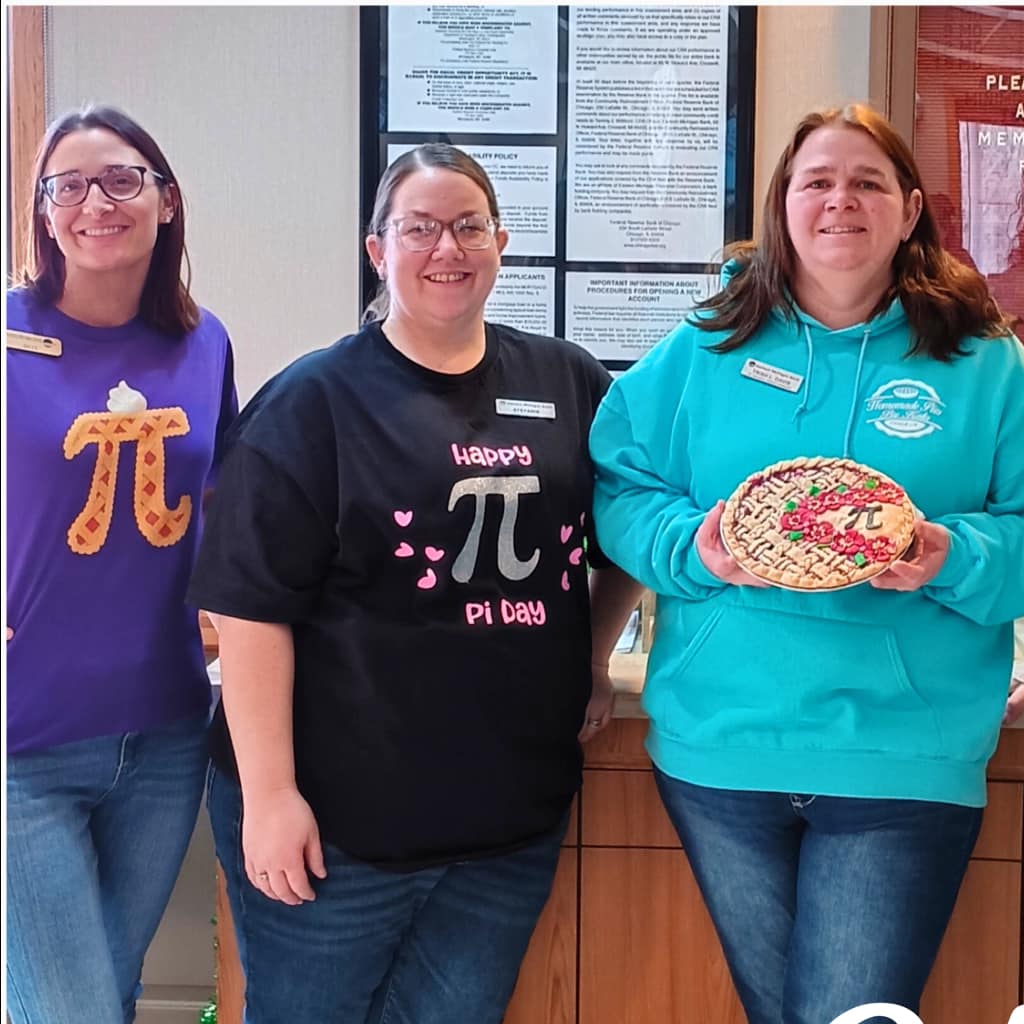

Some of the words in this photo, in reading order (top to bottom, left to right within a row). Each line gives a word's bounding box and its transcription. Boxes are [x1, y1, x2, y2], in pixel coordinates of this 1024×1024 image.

[587, 287, 633, 295] PROCEDURES
[628, 295, 661, 303] ACCOUNT
[465, 601, 493, 625] Pi
